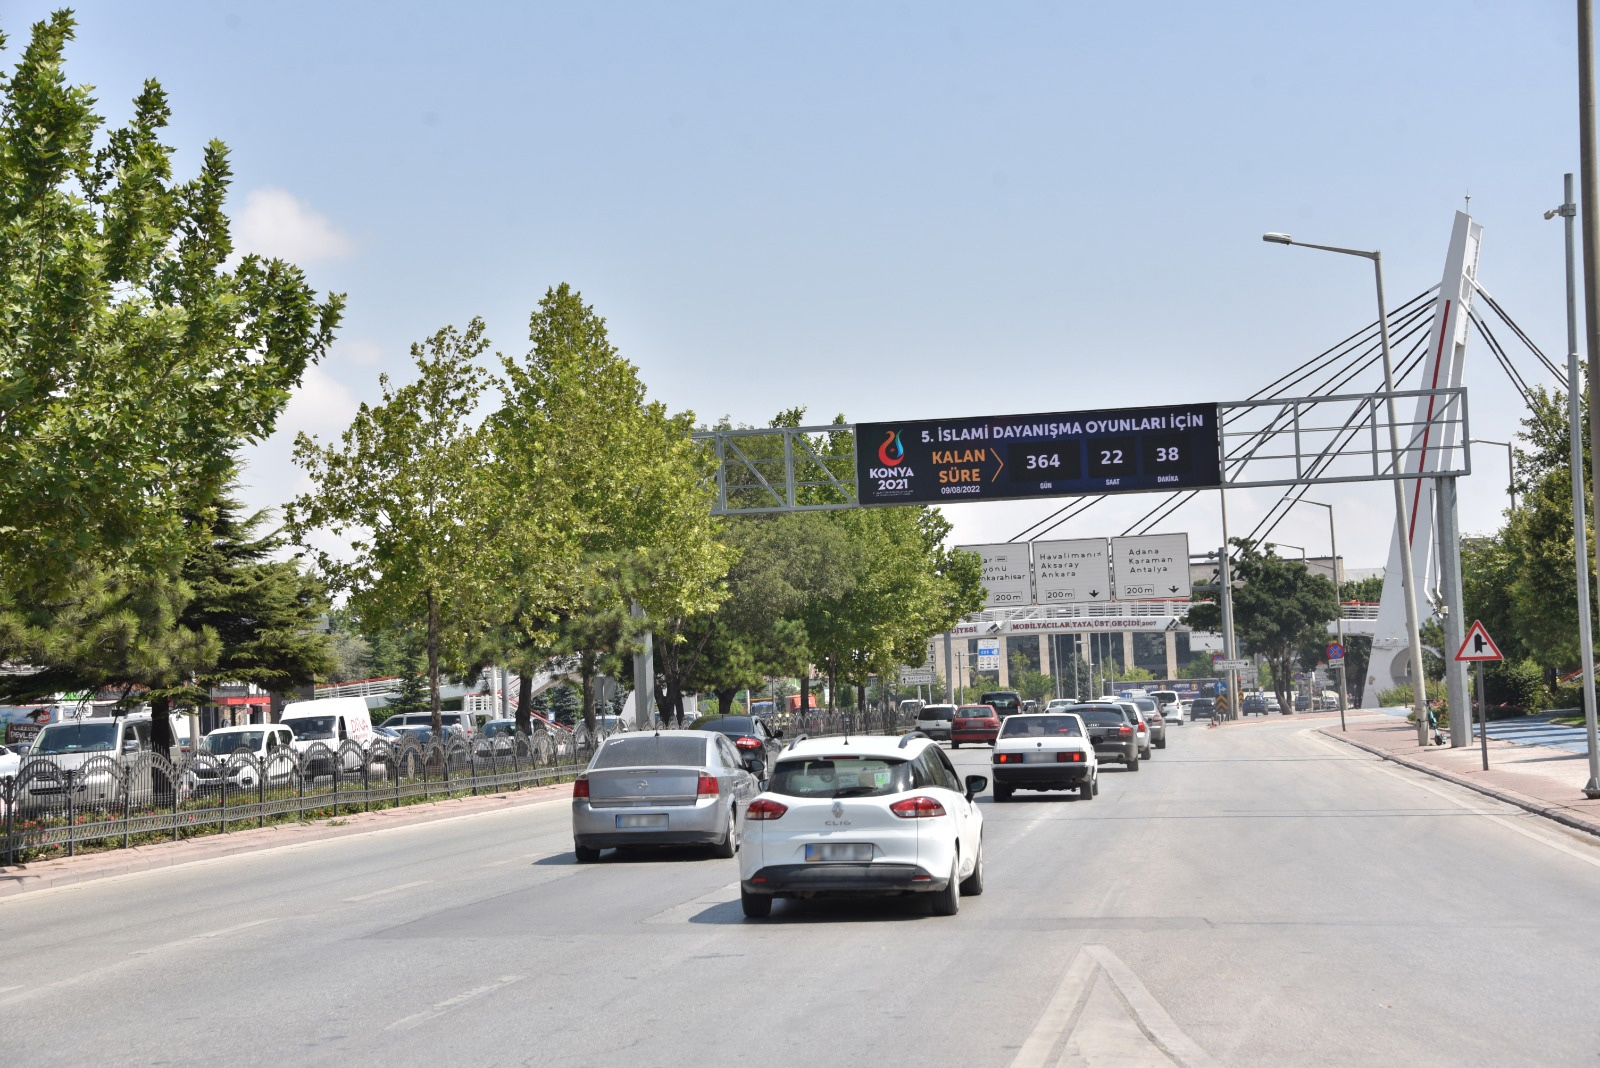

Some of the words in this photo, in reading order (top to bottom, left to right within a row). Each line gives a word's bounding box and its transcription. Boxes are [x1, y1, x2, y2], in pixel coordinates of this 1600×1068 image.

[921, 430, 935, 443] 5.
[938, 425, 989, 442] İSLAMİ
[993, 421, 1081, 440] DAYANIŞMA
[1085, 416, 1166, 434] OYUNLARI
[1170, 413, 1204, 430] İÇİN
[932, 447, 986, 465] KALAN
[1100, 450, 1123, 465] 22
[1156, 446, 1180, 462] 38
[1026, 454, 1061, 470] 364
[869, 466, 914, 479] KONYA
[939, 467, 981, 484] SÜRE
[1105, 478, 1120, 486] SAAT
[1157, 474, 1179, 483] DAKİKA
[877, 480, 908, 491] 2021
[941, 485, 981, 495] 09/08/2022
[1039, 552, 1096, 561] Havalimanı
[1128, 548, 1160, 556] Adana
[1041, 561, 1080, 570] Aksaray
[1128, 556, 1173, 565] Karaman
[1041, 570, 1076, 579] Ankara
[1129, 565, 1168, 574] Antalya
[1012, 620, 1071, 630] MOBİLYACILAR
[1072, 620, 1093, 629] YAYA
[1094, 619, 1110, 628] ÜST
[1111, 618, 1140, 628] GEÇİDİ
